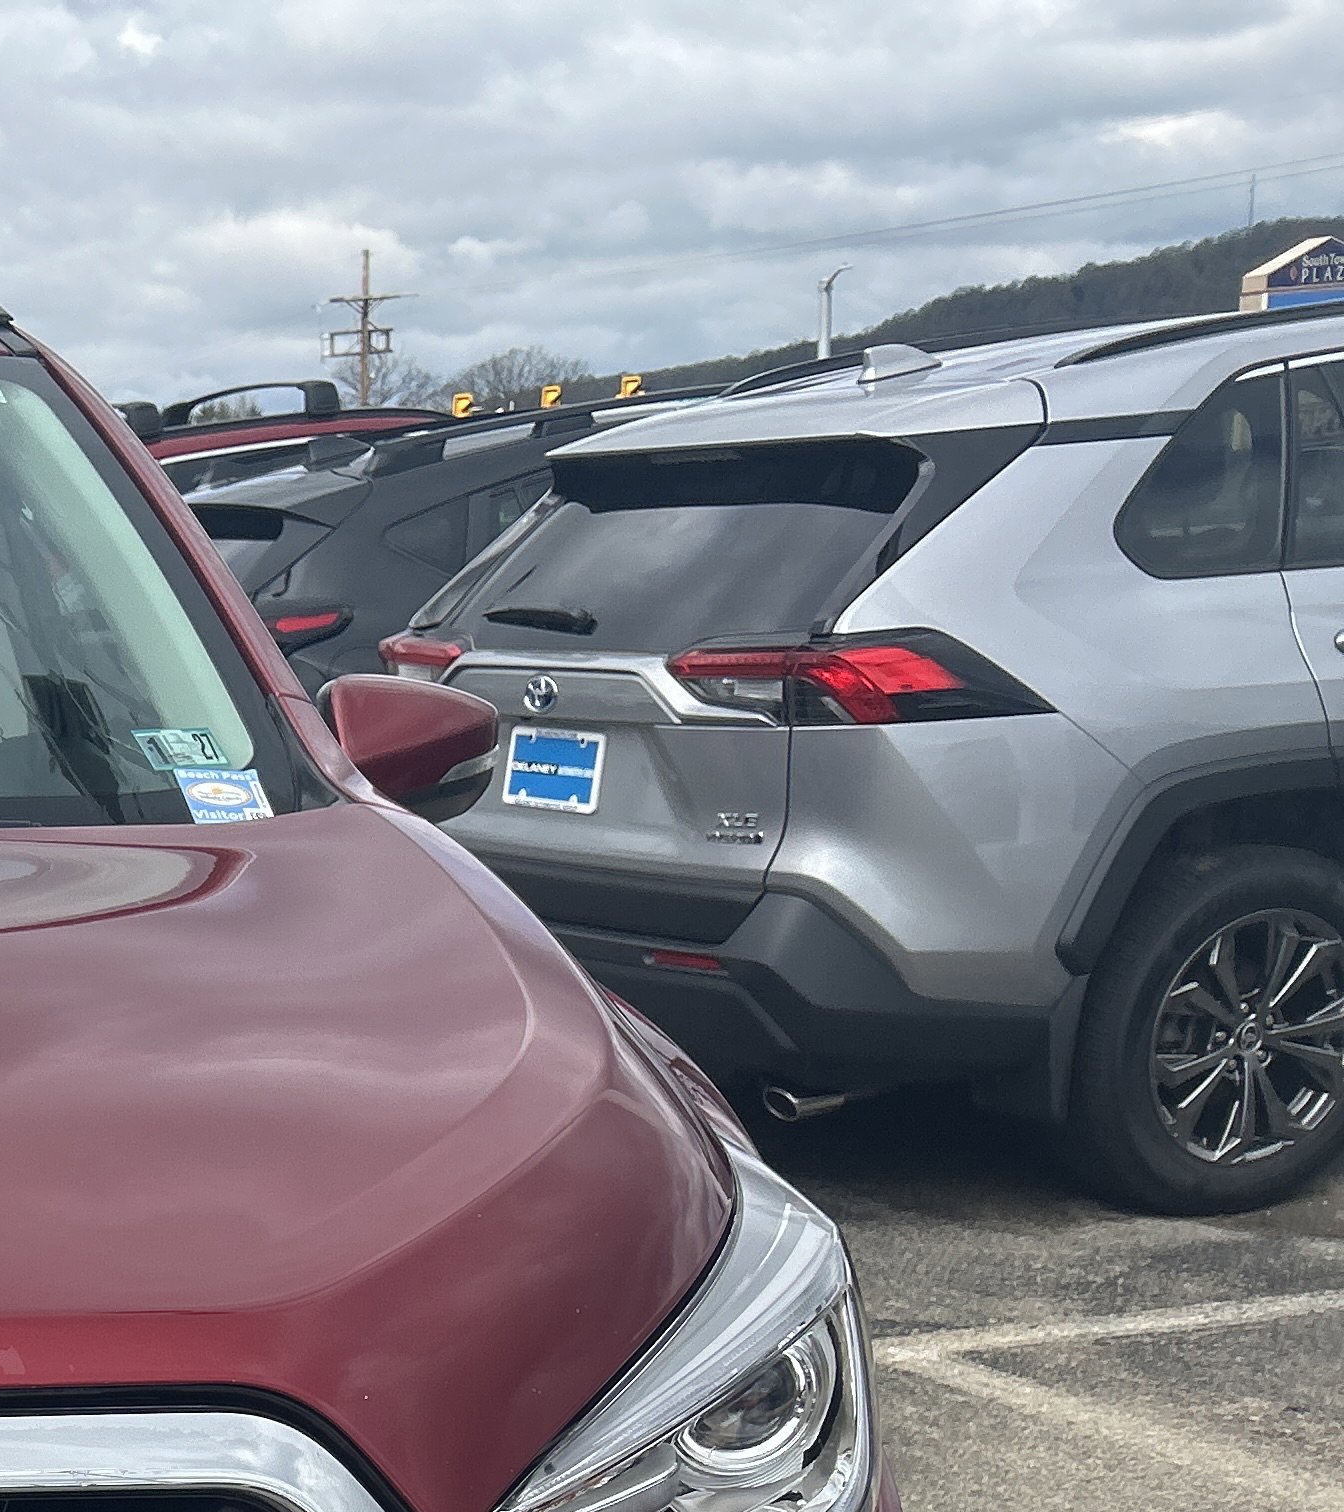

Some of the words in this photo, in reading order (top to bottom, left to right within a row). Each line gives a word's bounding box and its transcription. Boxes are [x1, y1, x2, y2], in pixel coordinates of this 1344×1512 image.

[1301, 254, 1329, 267] South
[1301, 265, 1344, 283] PLAZ
[191, 733, 220, 761] 27
[177, 769, 220, 780] Beach
[222, 771, 253, 781] Pass
[192, 808, 244, 821] Visitor
